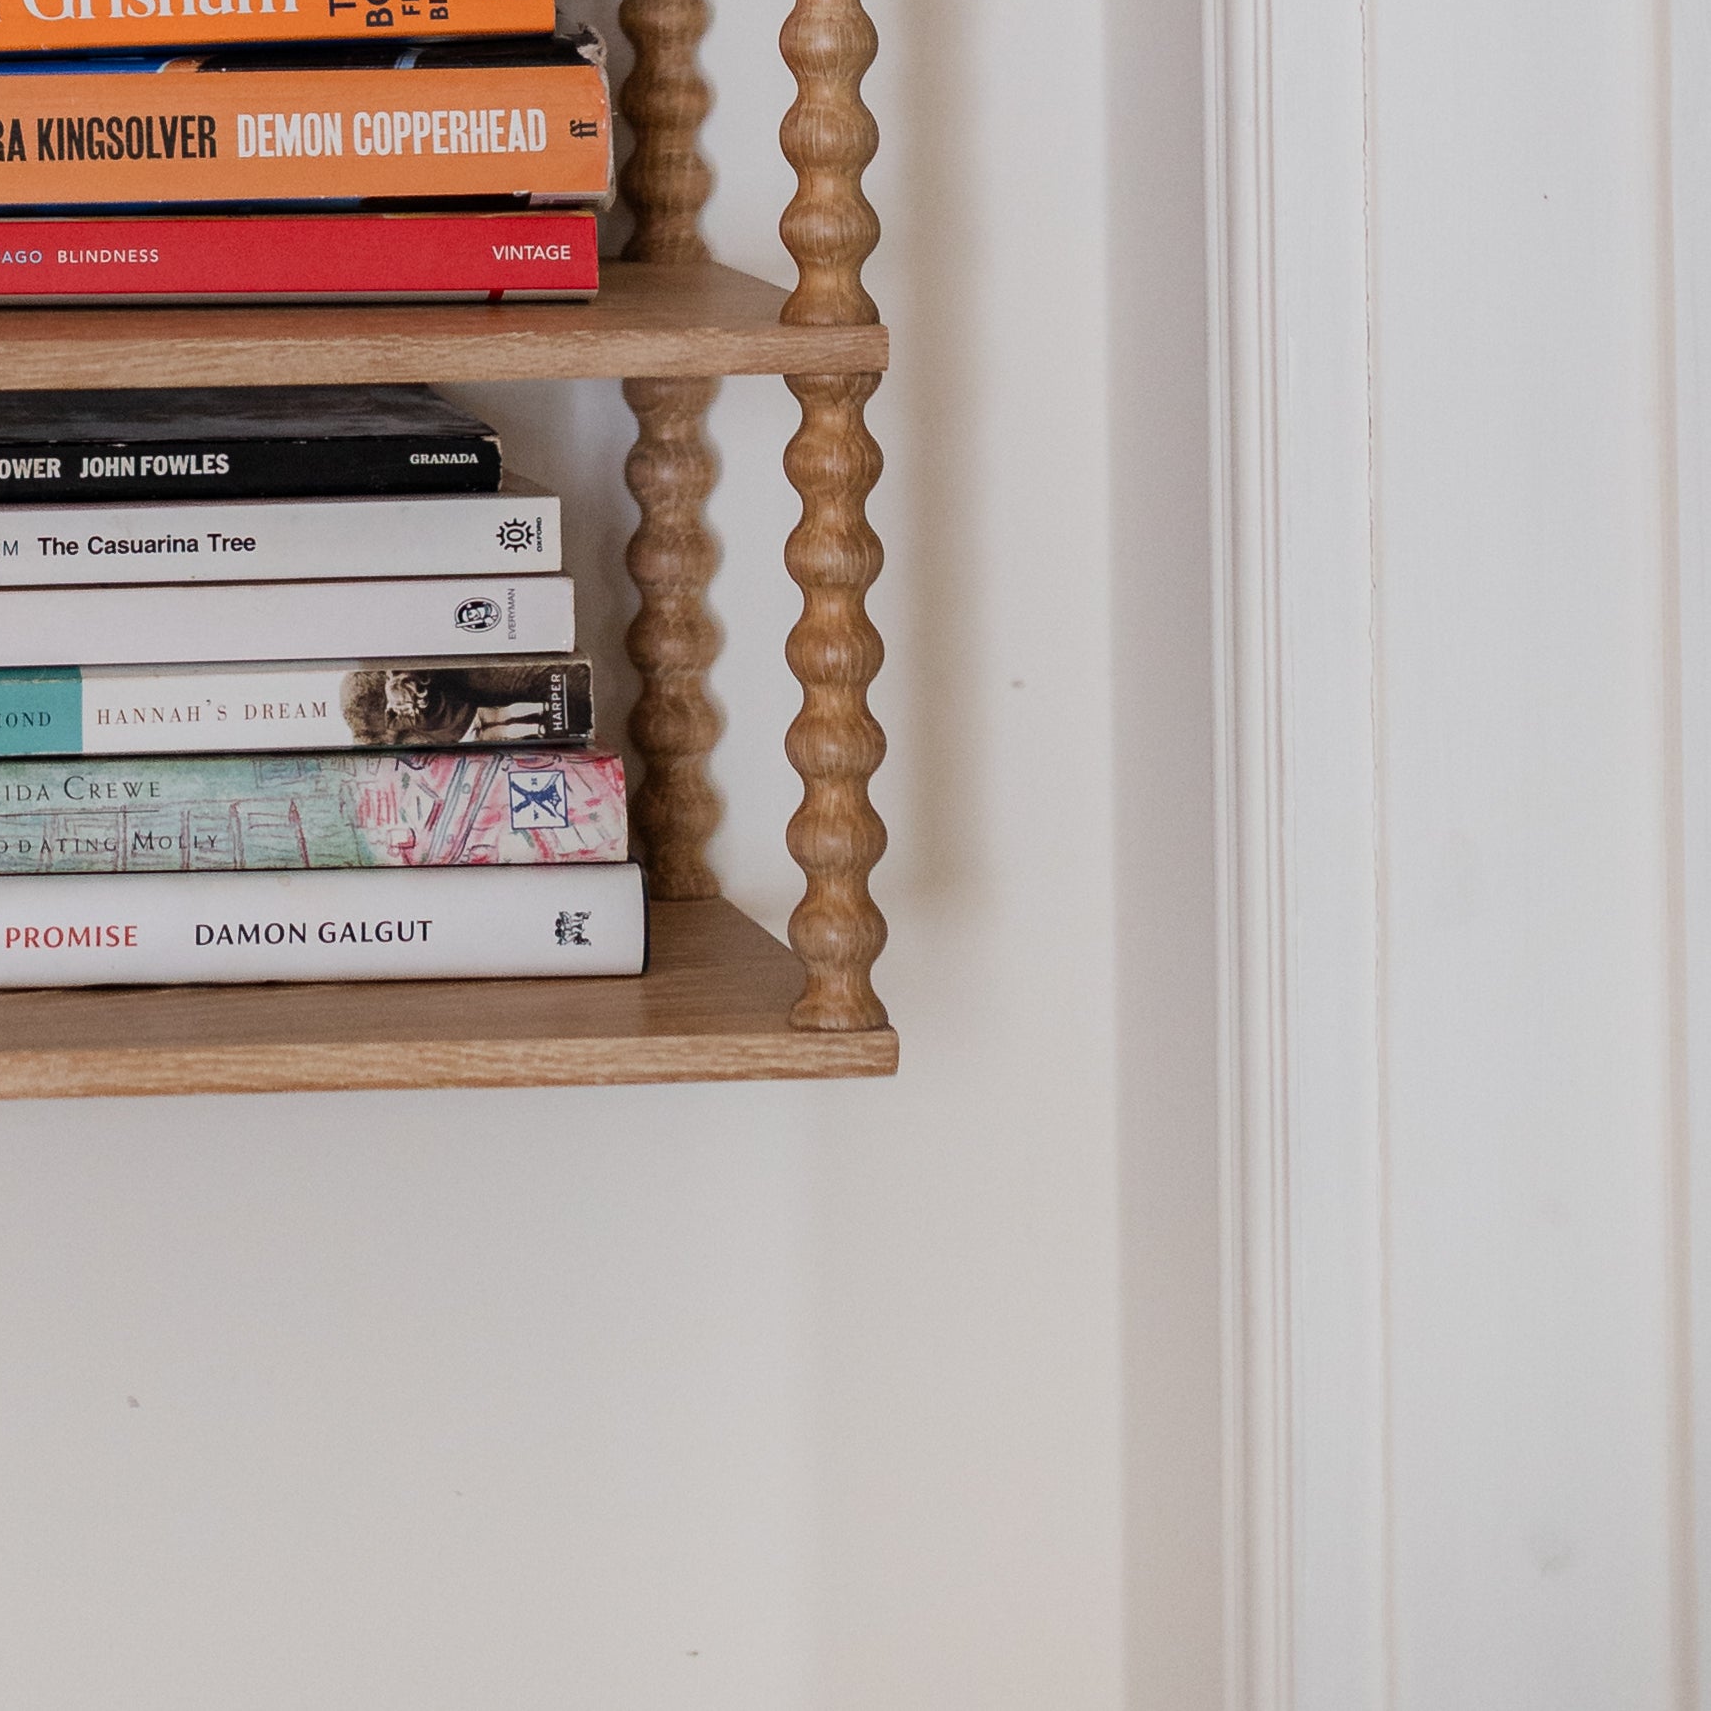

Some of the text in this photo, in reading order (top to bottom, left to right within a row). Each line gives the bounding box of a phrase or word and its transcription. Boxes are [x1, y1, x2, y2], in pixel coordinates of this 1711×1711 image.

[37, 114, 218, 162] KINGSOLVER
[237, 112, 343, 159] DEMON
[352, 108, 547, 156] COPPERHEAD
[57, 249, 160, 264] BLINDNESS
[492, 245, 571, 261] VINTAGE
[80, 455, 136, 479] JOHN
[140, 453, 230, 476] FOWLES
[409, 452, 479, 466] GRANADA
[37, 537, 79, 556] The
[87, 534, 199, 556] Casuarina
[207, 533, 257, 553] Tree
[243, 701, 329, 720] DREAM
[62, 774, 161, 801] CREWE
[131, 830, 218, 851] MOLLY
[5, 924, 139, 949] PROMISE
[194, 922, 307, 947] DAMON
[318, 920, 433, 944] GALGUT
